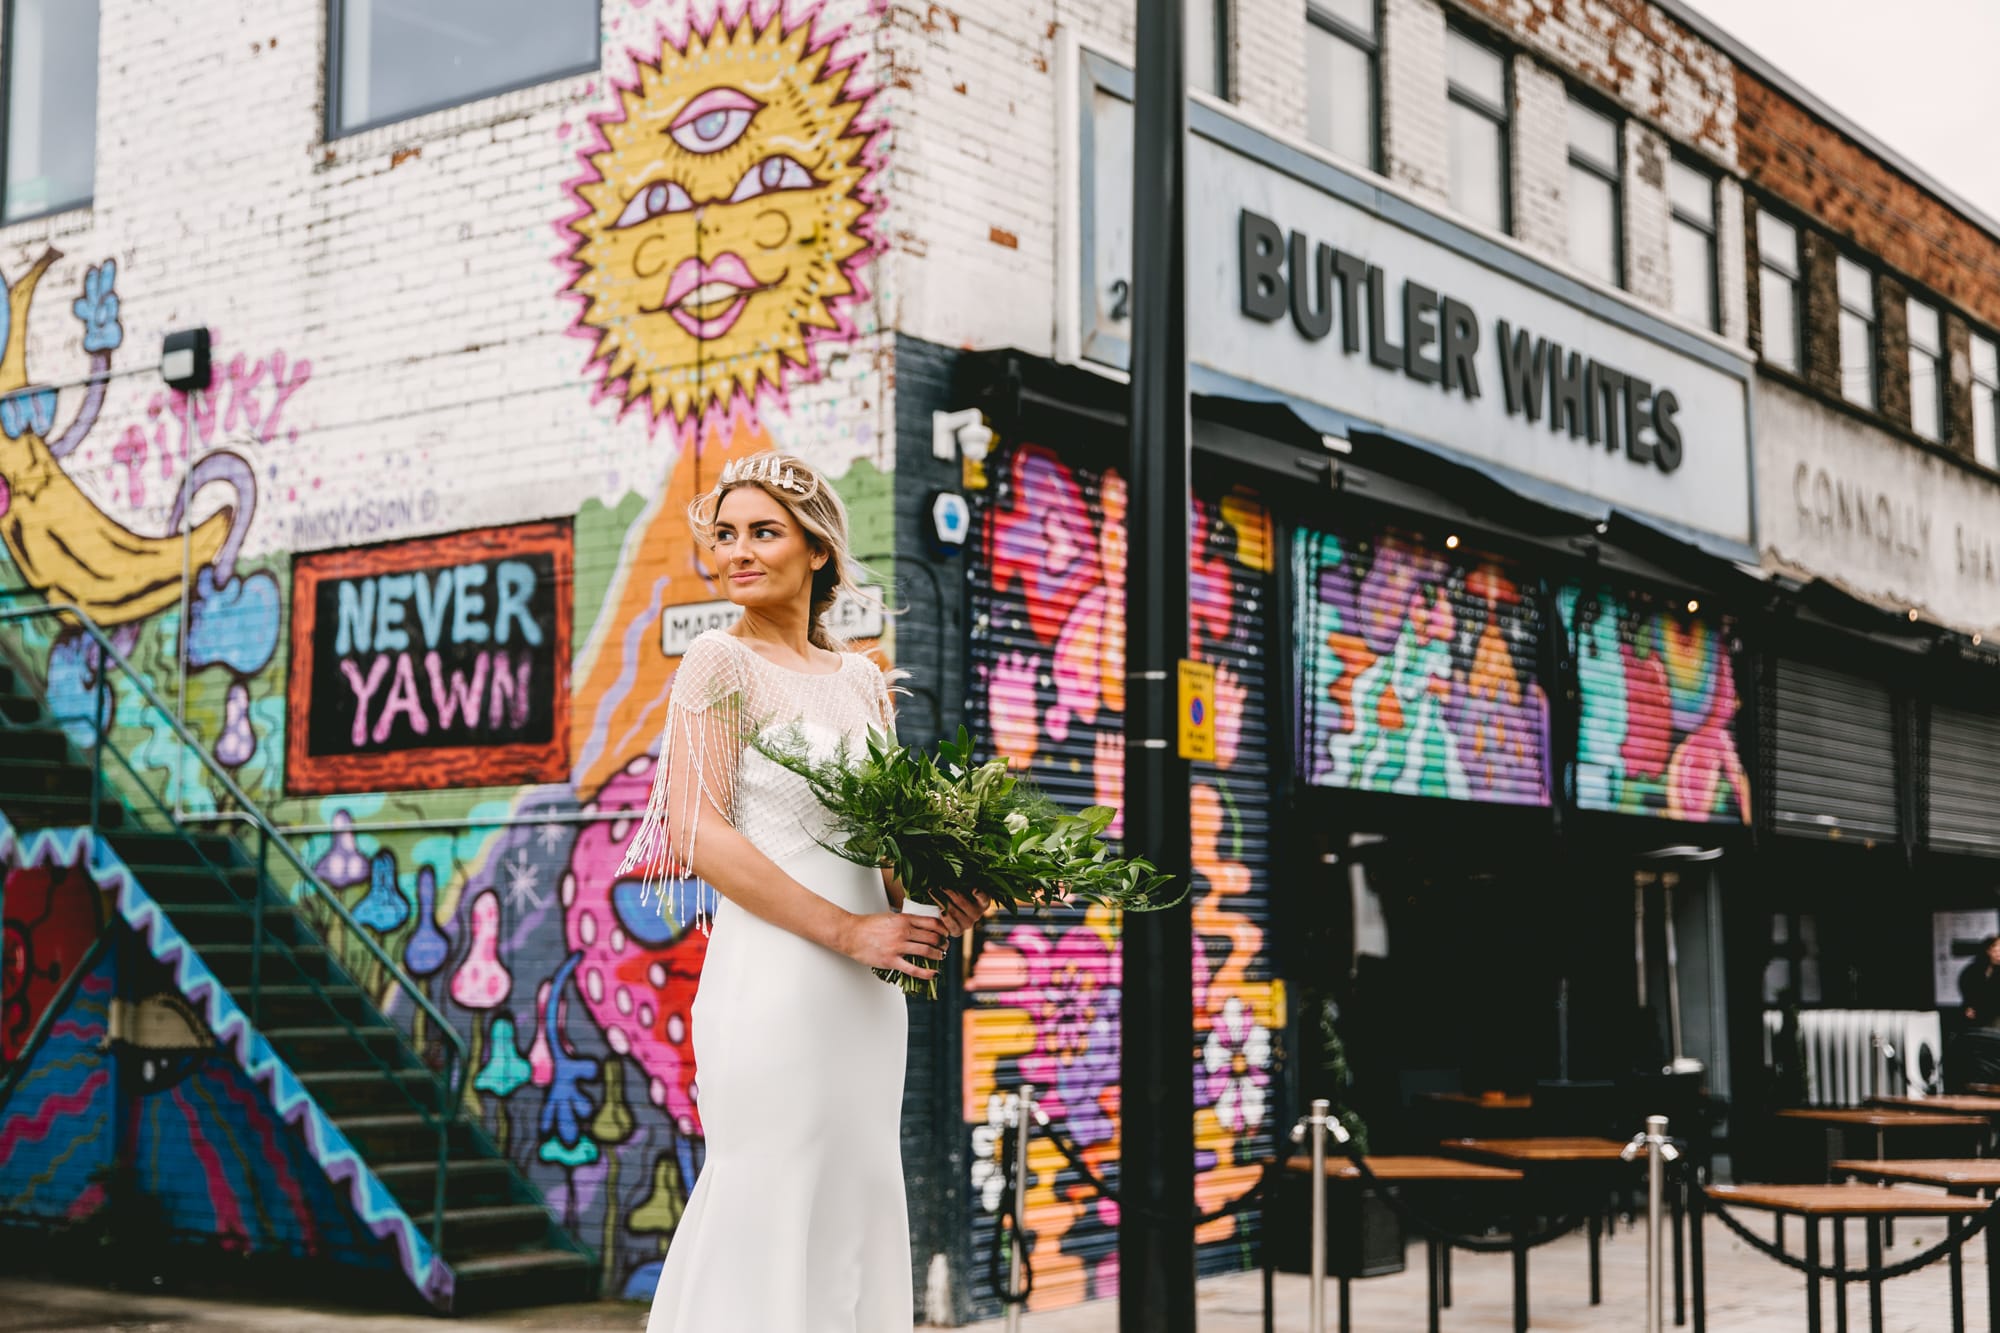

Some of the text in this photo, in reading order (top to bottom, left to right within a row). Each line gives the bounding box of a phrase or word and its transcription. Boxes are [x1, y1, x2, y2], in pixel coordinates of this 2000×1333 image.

[1241, 208, 1683, 473] BUTLER WHITES
[335, 560, 543, 656] NEVER
[340, 650, 531, 746] YAWN
